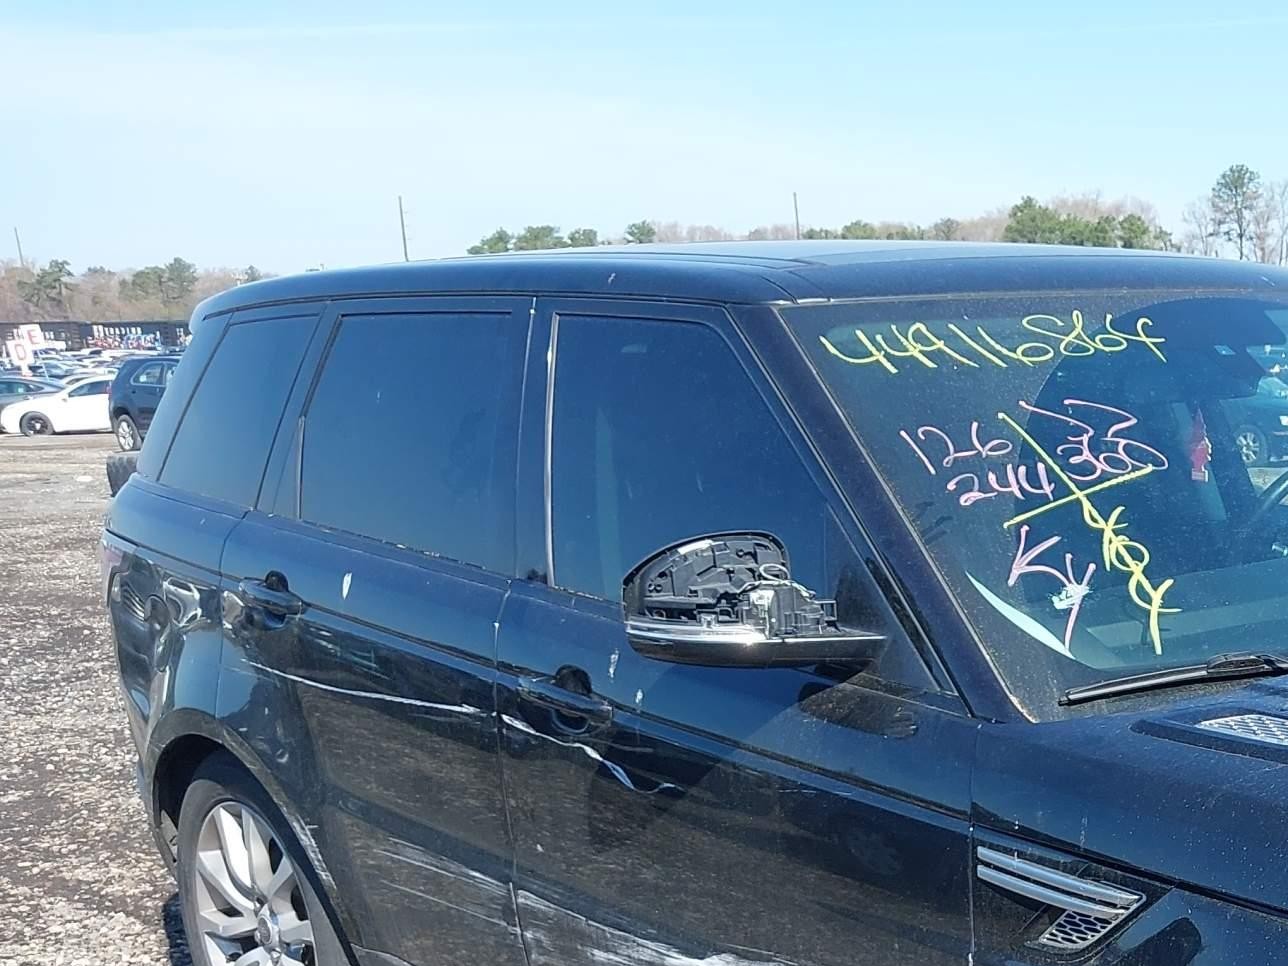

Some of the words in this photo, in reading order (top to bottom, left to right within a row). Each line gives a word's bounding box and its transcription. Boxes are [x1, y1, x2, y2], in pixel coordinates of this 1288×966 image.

[819, 309, 1168, 374] 44916864
[899, 421, 1014, 477] 126
[946, 462, 1055, 506] 244
